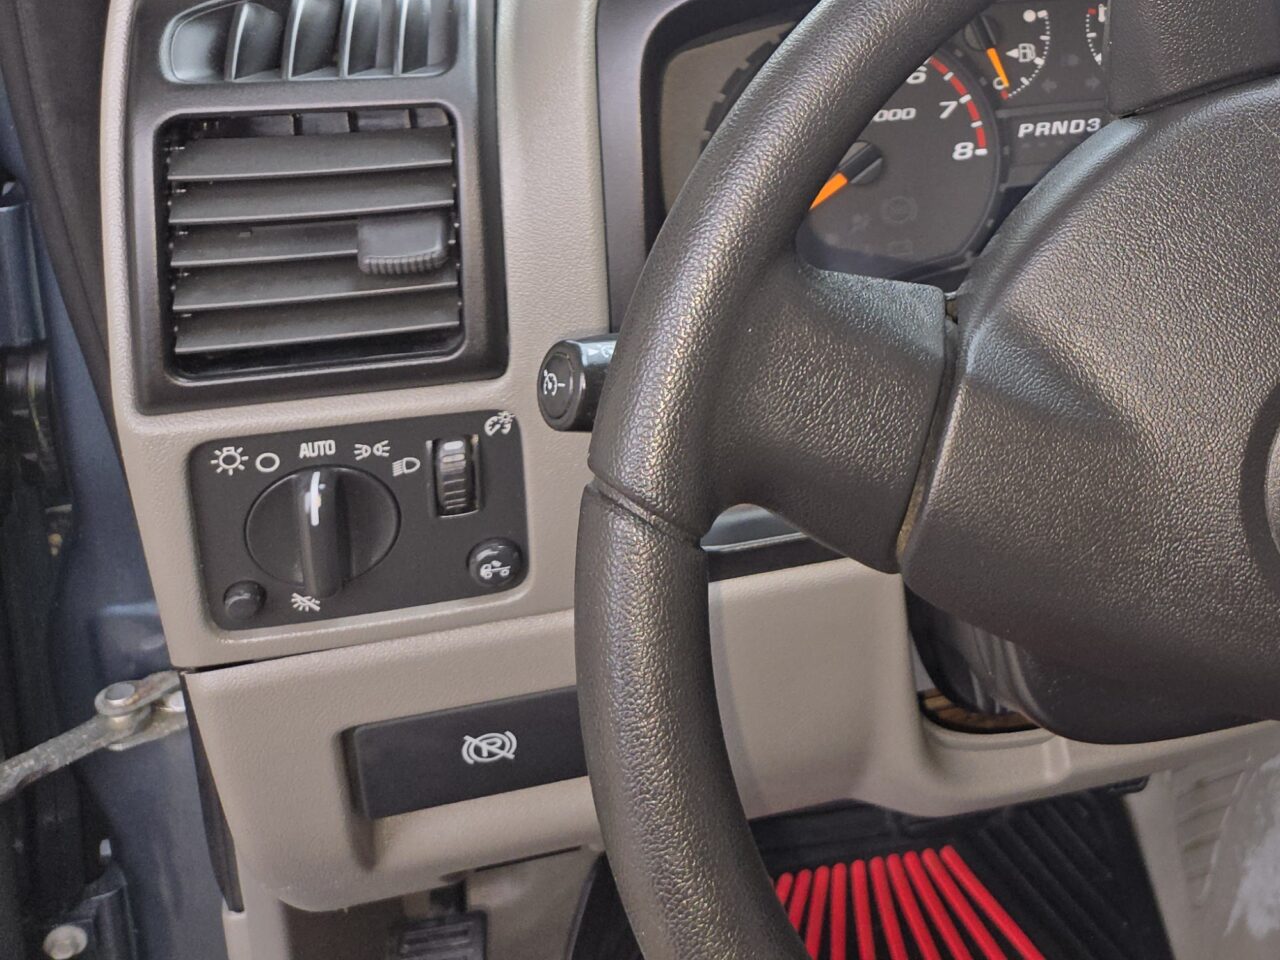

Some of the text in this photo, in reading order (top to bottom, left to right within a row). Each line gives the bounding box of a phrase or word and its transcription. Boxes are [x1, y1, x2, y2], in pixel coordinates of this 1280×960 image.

[906, 65, 928, 84] 6
[939, 100, 959, 119] 7
[952, 141, 975, 161] 8
[299, 439, 336, 459] AUTO
